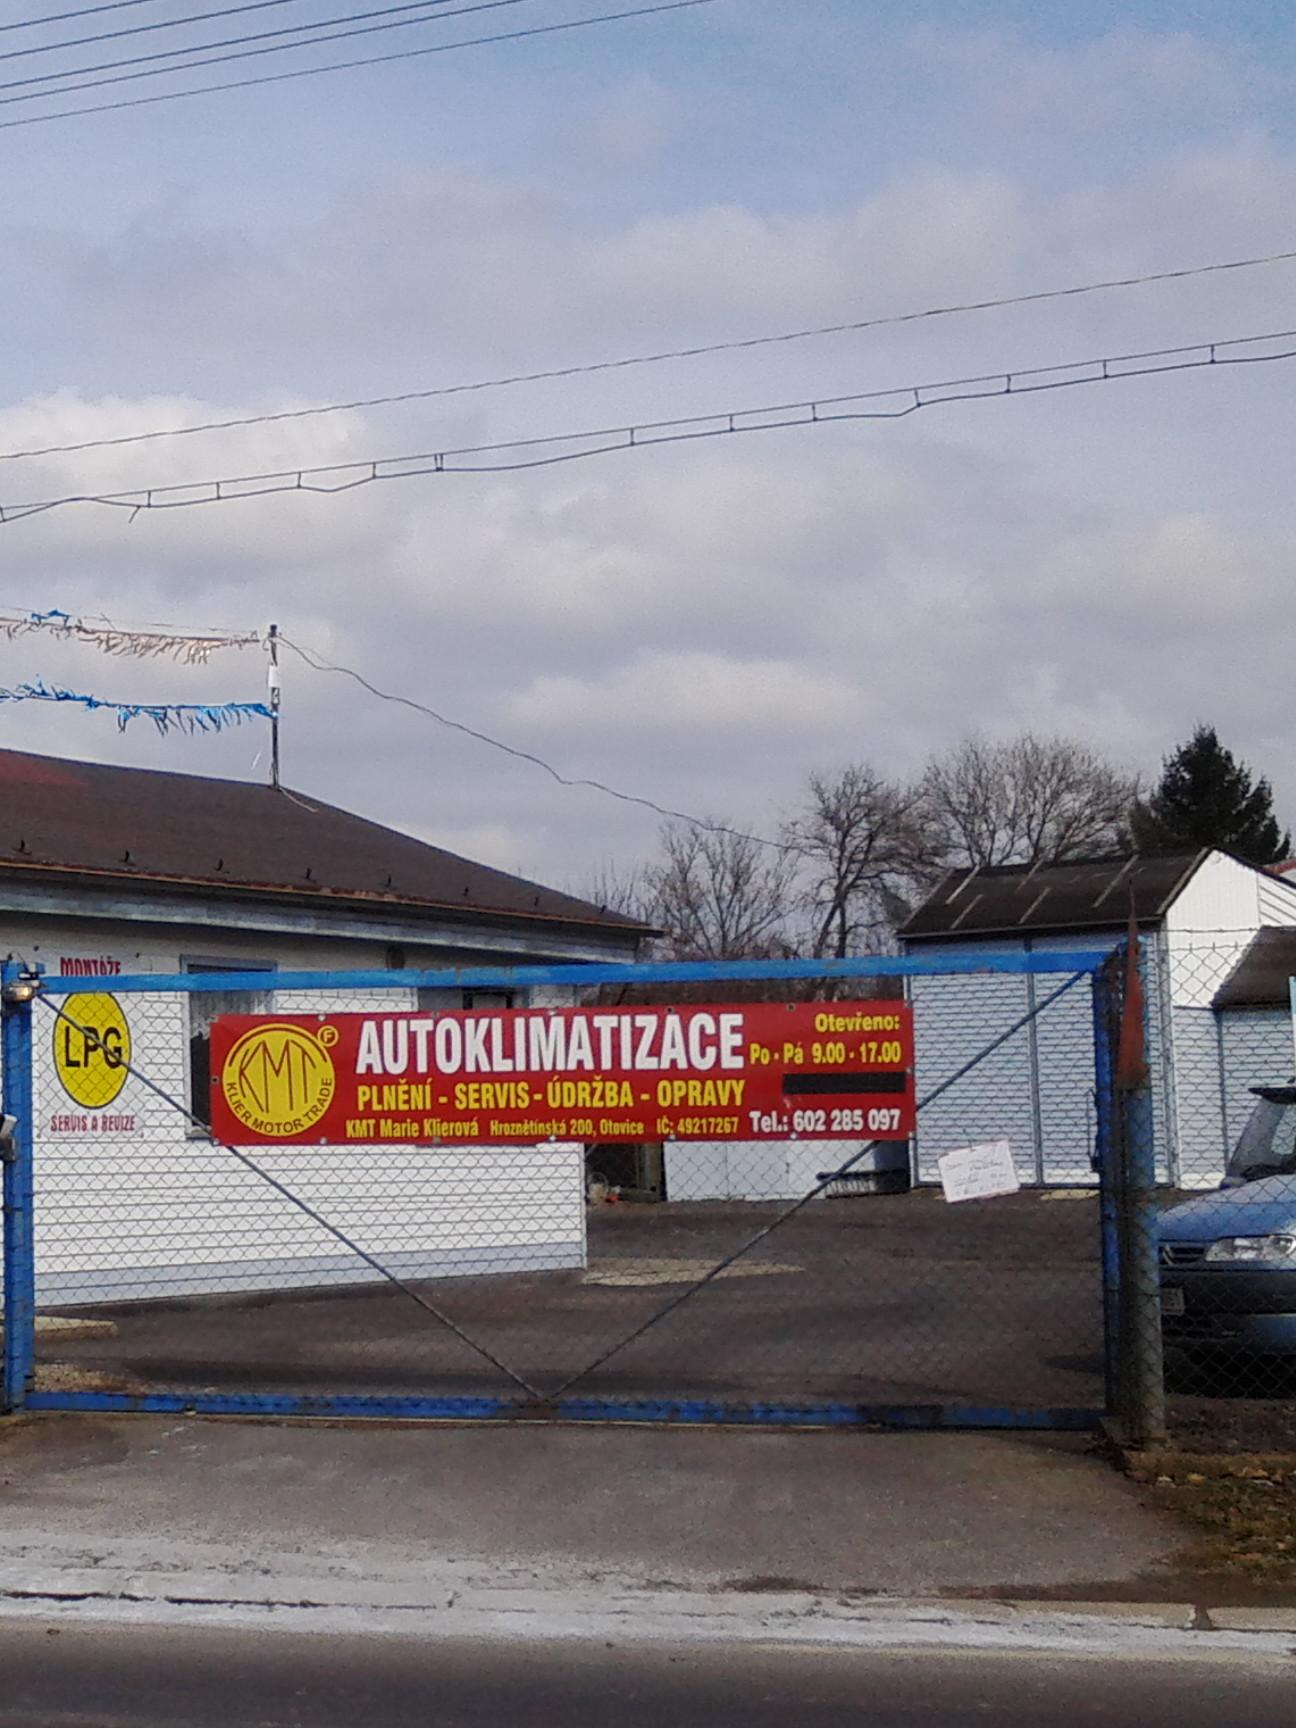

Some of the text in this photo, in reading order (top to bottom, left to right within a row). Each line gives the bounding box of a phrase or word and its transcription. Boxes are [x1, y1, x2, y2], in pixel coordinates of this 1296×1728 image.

[814, 1012, 900, 1032] Otevřeno:
[64, 1026, 123, 1069] LPG
[356, 1013, 744, 1074] AUTOKLIMATIZACE
[749, 1043, 770, 1065] Po
[783, 1041, 804, 1064] Pá
[812, 1042, 846, 1064] 9.00
[859, 1041, 901, 1063] 17.00
[239, 1040, 316, 1114] KMT
[226, 1078, 333, 1134] KLIER MOTOR TRADE
[357, 1078, 432, 1111] PLNĚNÍ
[454, 1081, 530, 1110] SERVIS
[547, 1075, 634, 1108] ÚDRŽBA
[657, 1079, 745, 1107] OPRAVY
[50, 1115, 135, 1132] SERVIS A REVIZE
[346, 1118, 376, 1138] KMT
[380, 1118, 420, 1137] Marie
[424, 1116, 479, 1137] Klierová
[599, 1118, 644, 1136] Otovice
[677, 1116, 739, 1134] 49217267
[749, 1109, 901, 1132] Tel.: 602 285 097
